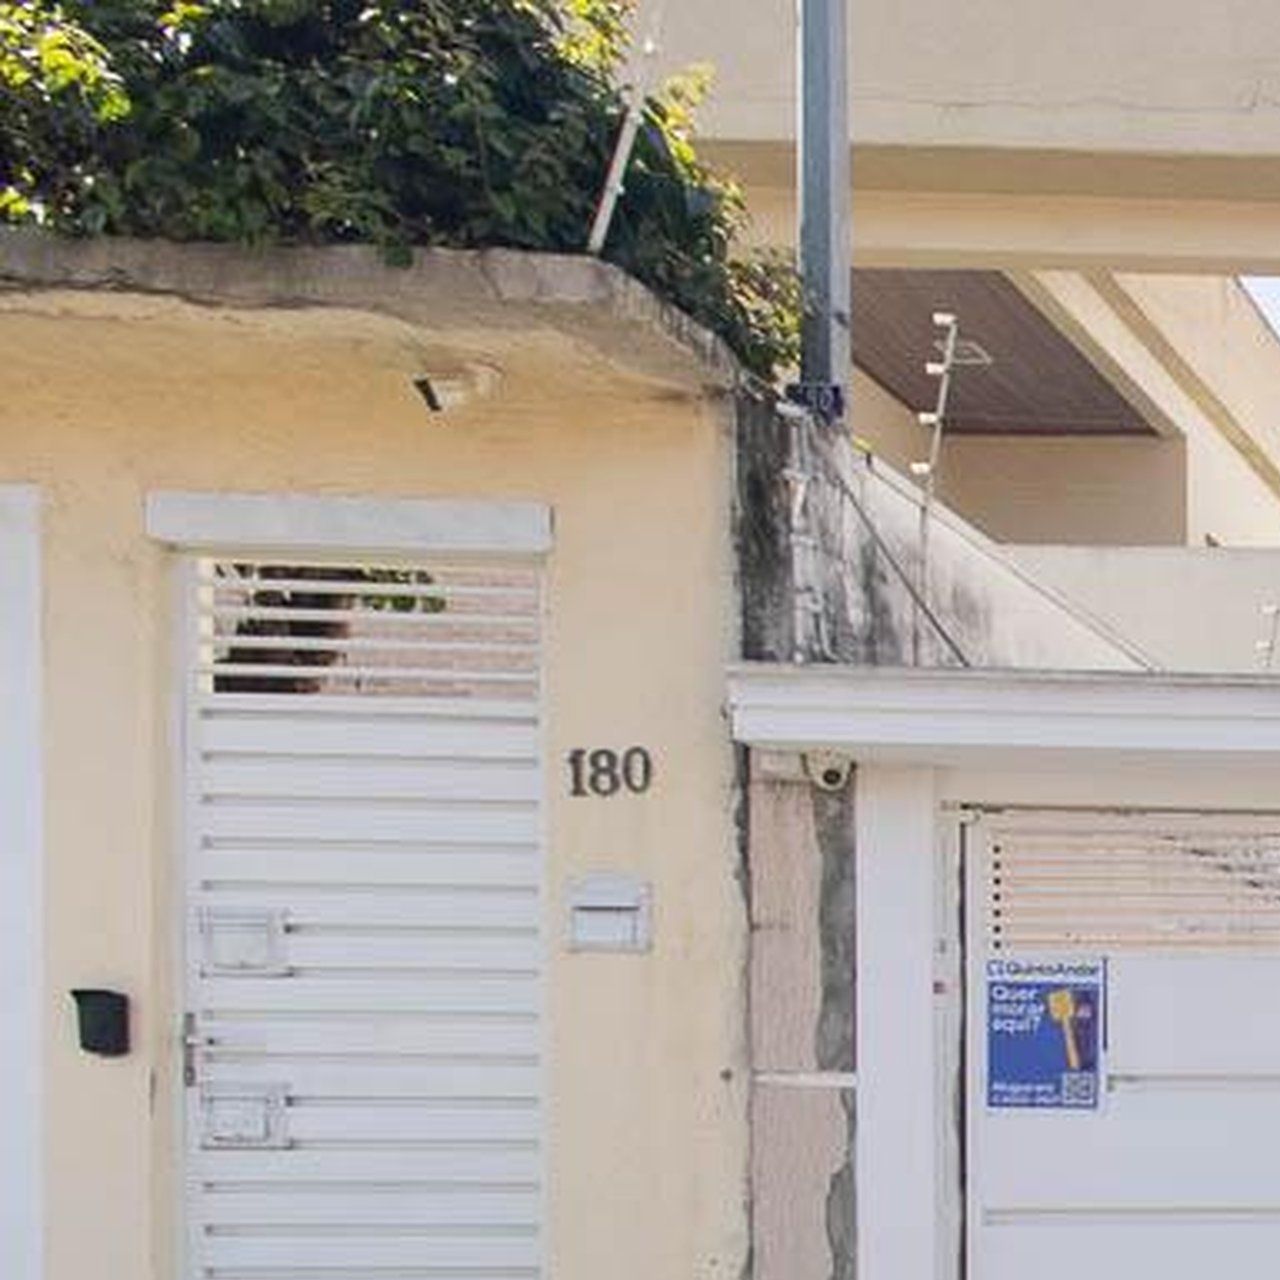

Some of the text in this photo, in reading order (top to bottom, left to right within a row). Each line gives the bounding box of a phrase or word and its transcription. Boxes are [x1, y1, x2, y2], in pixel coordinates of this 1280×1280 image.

[568, 745, 652, 797] 180
[992, 985, 1038, 1001] Quer
[992, 1016, 1040, 1034] aqui?
